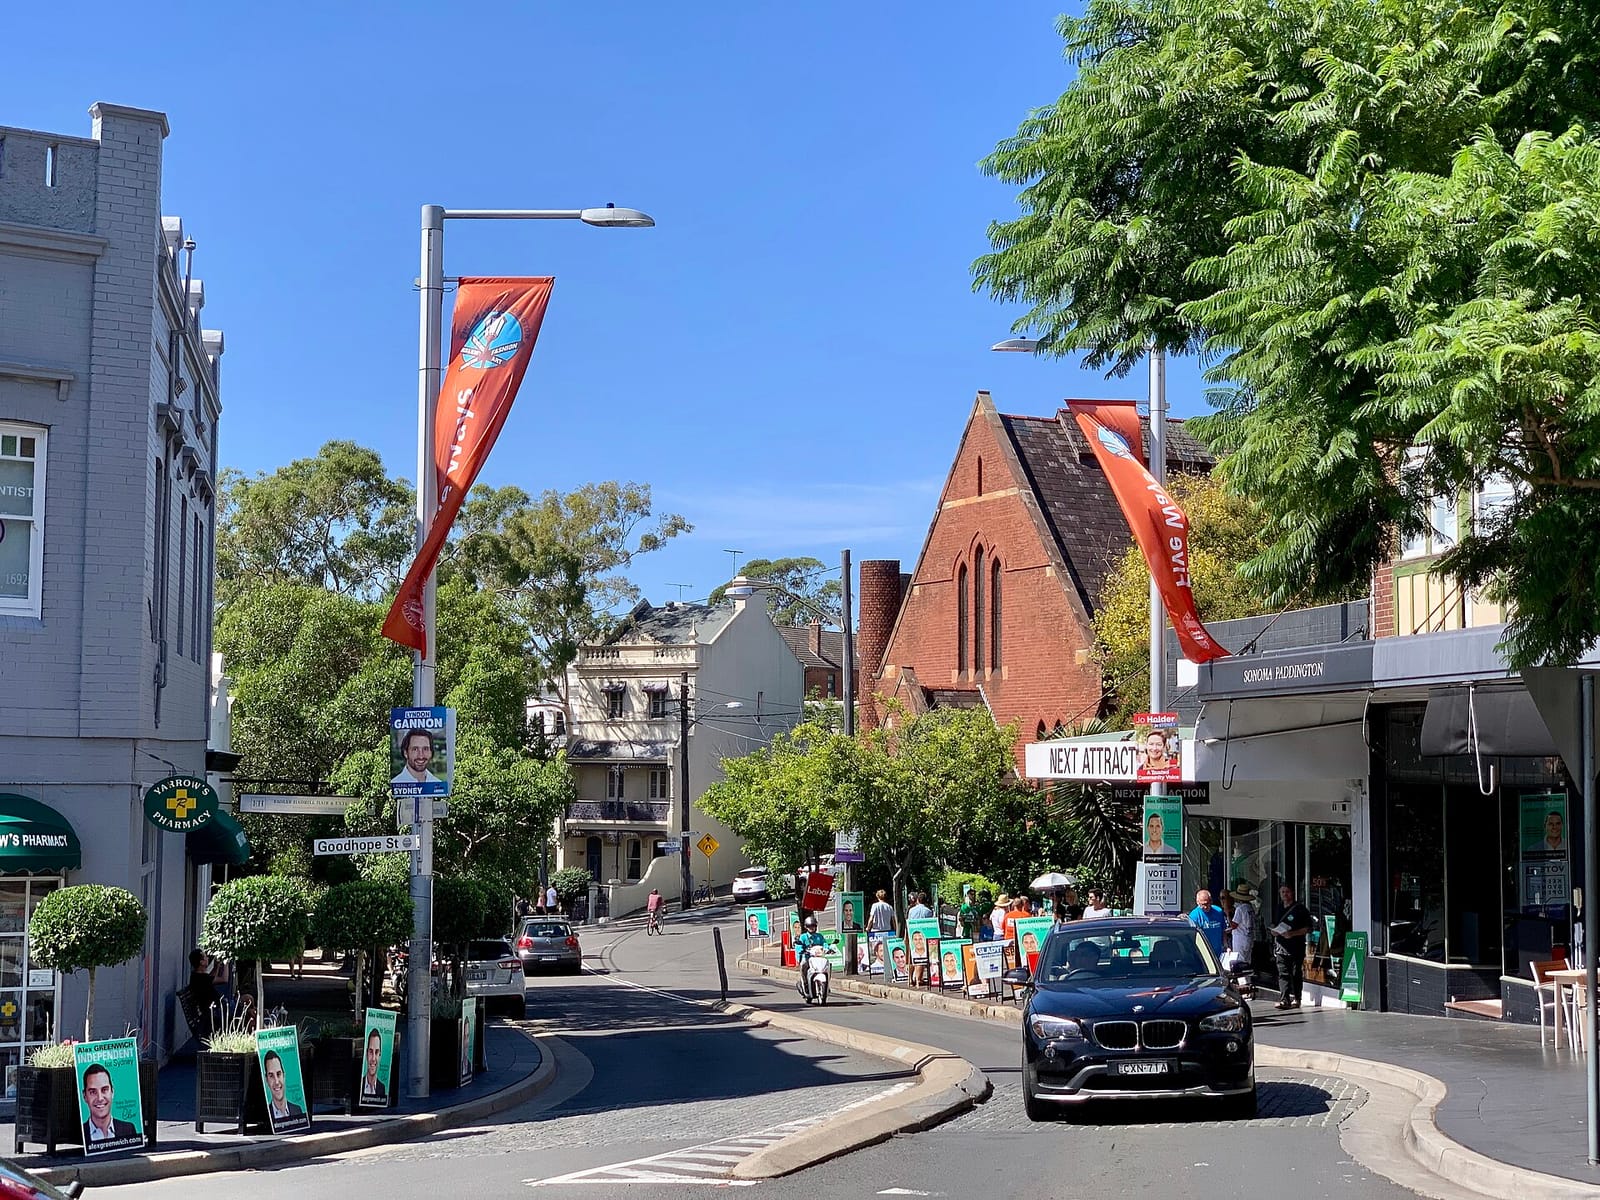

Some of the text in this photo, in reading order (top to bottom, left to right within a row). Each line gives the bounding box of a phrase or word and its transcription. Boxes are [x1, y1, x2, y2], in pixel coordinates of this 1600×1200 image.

[1243, 662, 1324, 683] SONOMA PADDINGTON
[394, 718, 443, 729] GANNON
[1136, 715, 1145, 724] Jo
[1049, 747, 1078, 774] NEXT
[153, 779, 210, 796] YARROW'S
[393, 787, 423, 795] SYDNEY
[1115, 790, 1141, 798] NEXT
[152, 809, 212, 829] PHARMACY
[22, 834, 68, 847] PHARMACY
[318, 837, 399, 853] Goodhope St
[807, 885, 830, 897] Labor
[78, 1041, 134, 1054] Alex GREENWICH
[77, 1048, 134, 1065] INDEPENDENT
[113, 1058, 134, 1068] Sydney
[88, 1137, 142, 1150] alexgreenwich.com
